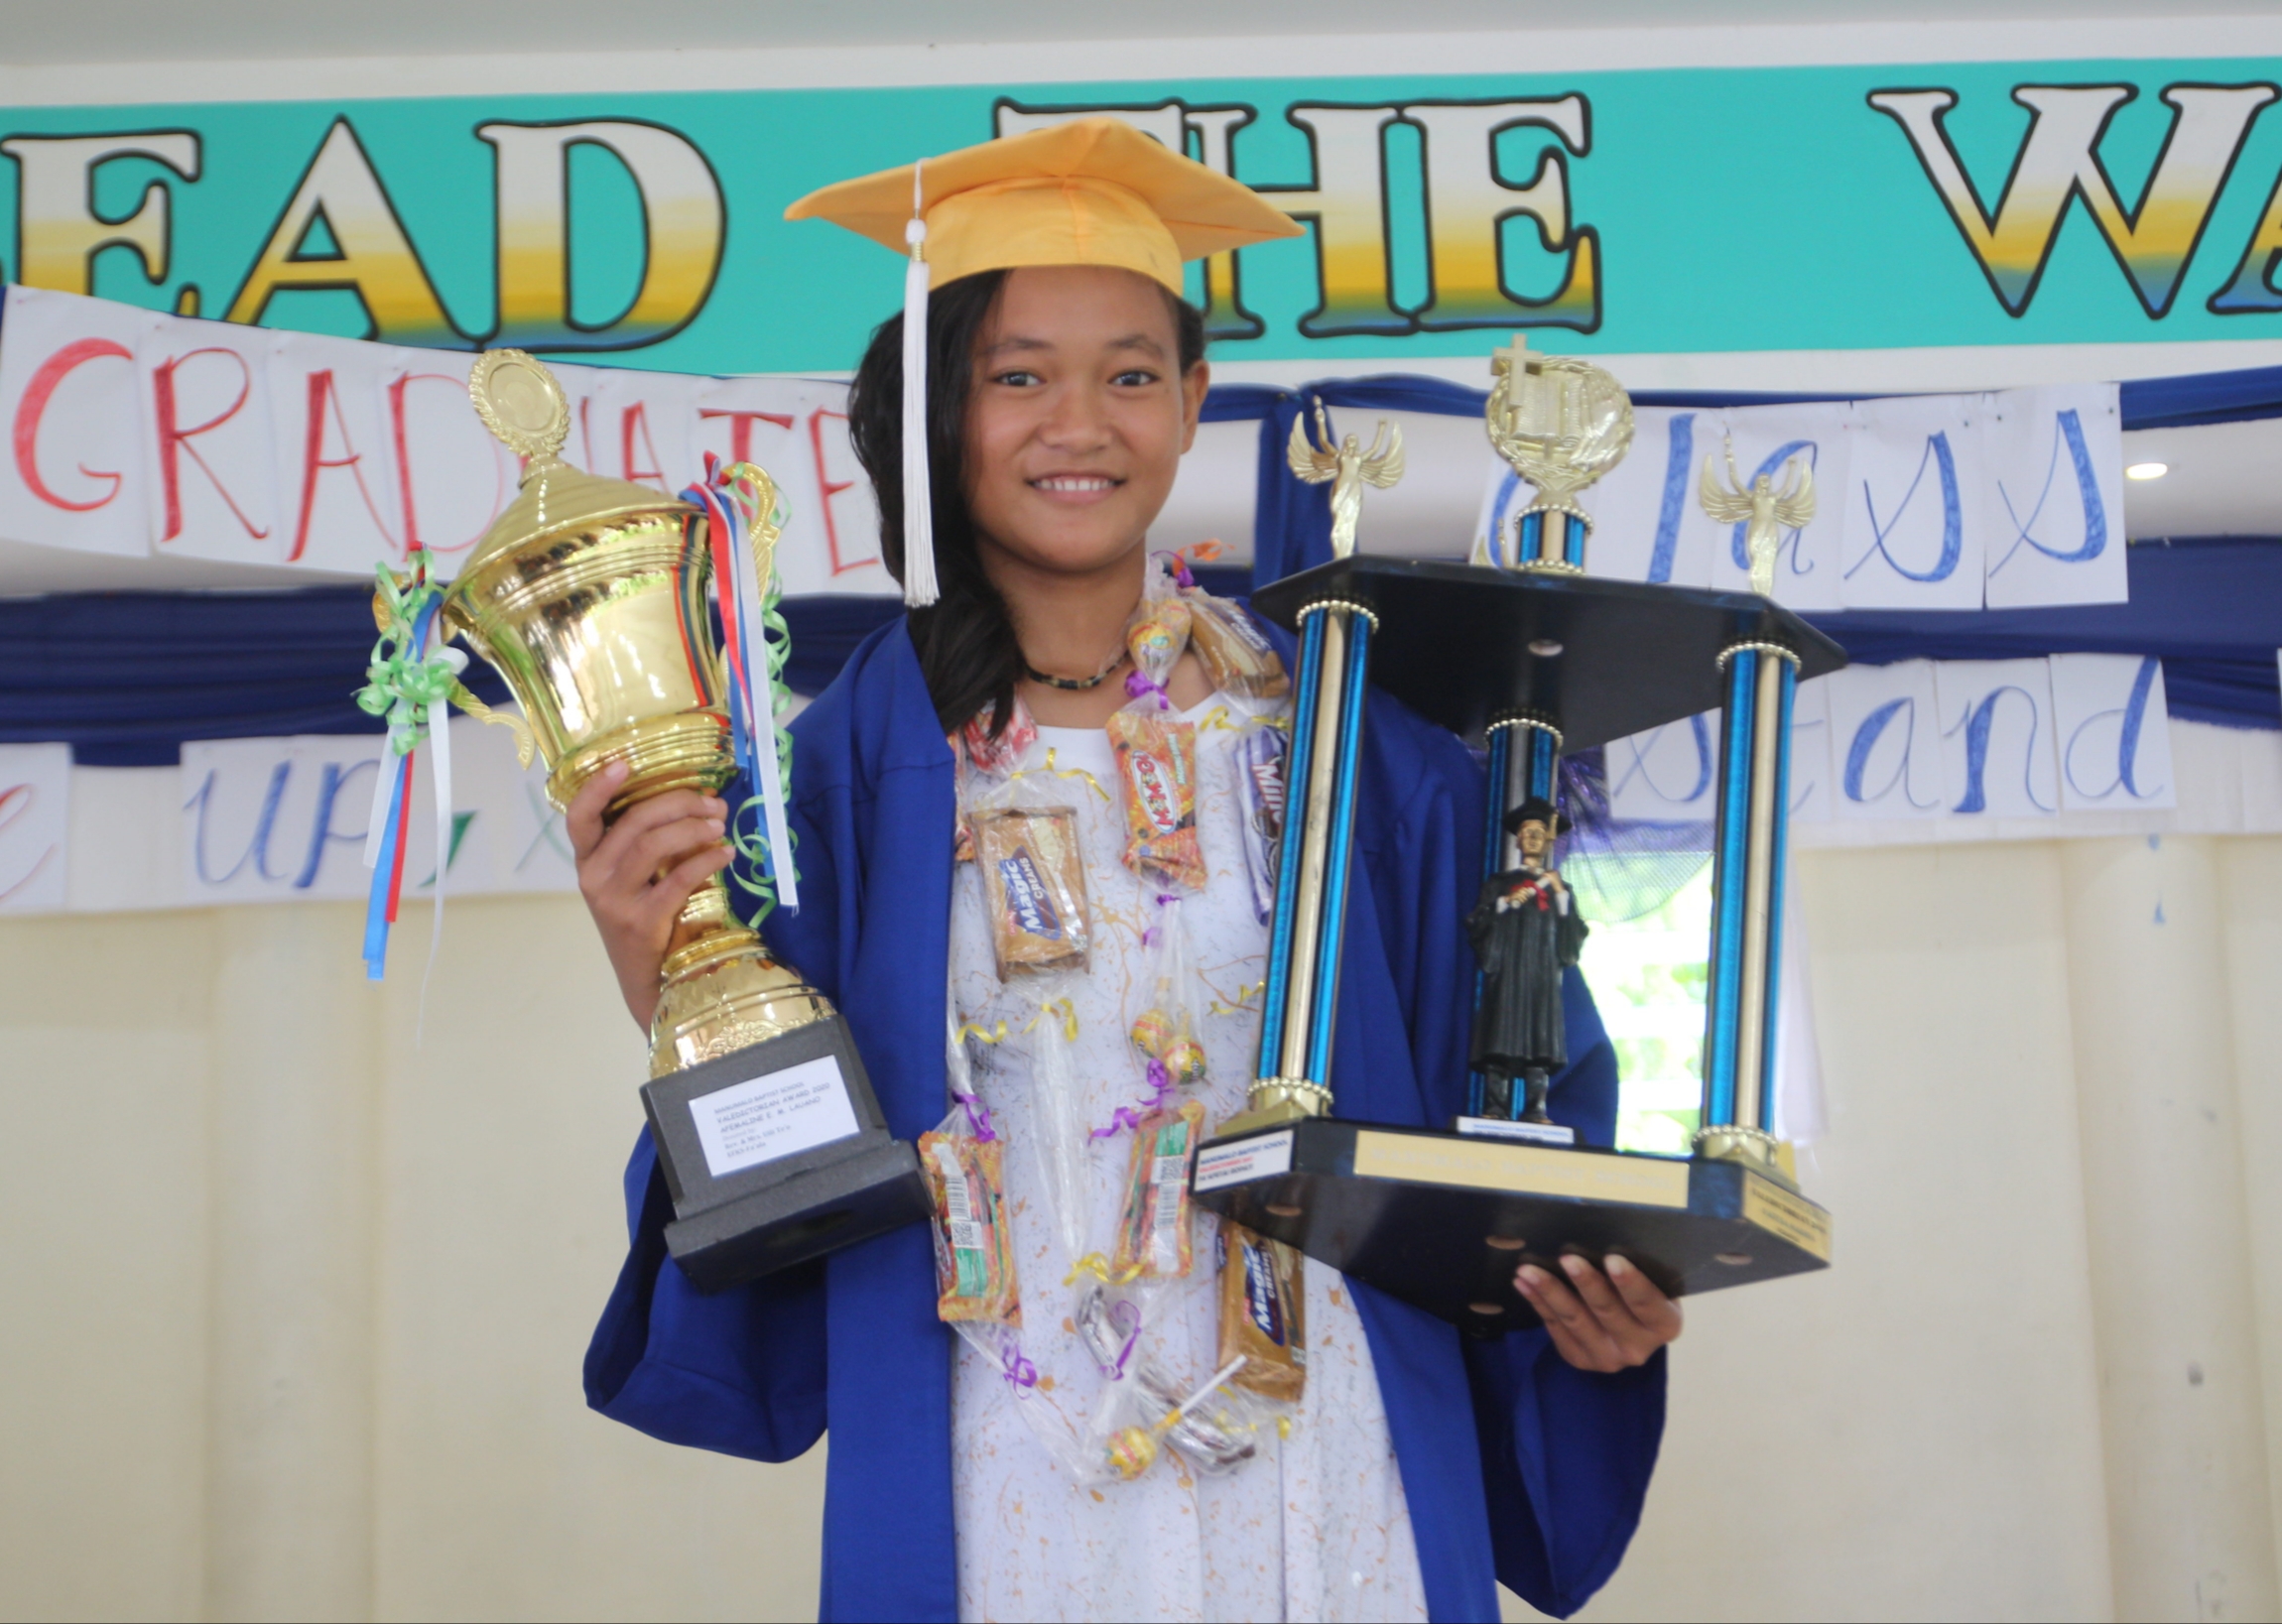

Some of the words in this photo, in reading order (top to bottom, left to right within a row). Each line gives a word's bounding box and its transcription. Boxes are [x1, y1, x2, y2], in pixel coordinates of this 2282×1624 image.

[0, 114, 727, 352] EAD
[992, 91, 1603, 339] HE
[13, 337, 880, 577] GRADATE
[1005, 860, 1043, 930] Magic
[1019, 857, 1044, 900] CREAMS
[781, 1089, 810, 1102] AWARD
[1247, 1247, 1272, 1330] Magic
